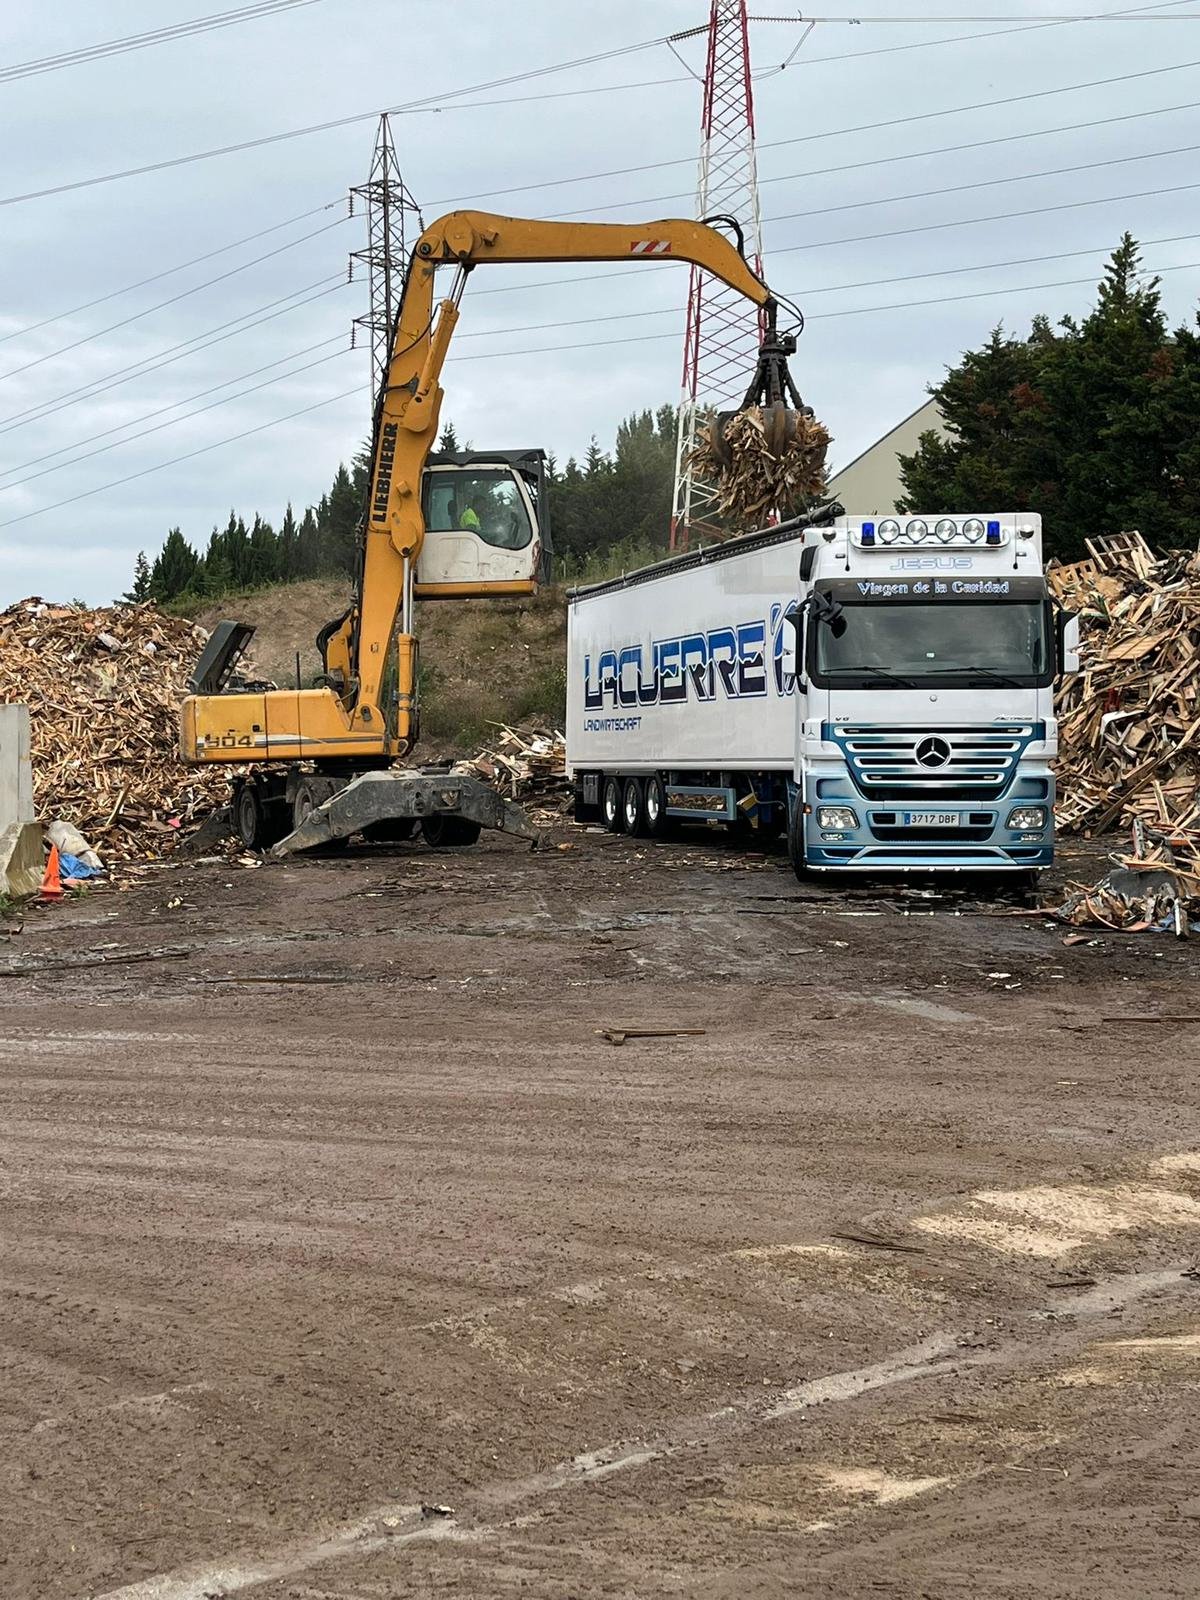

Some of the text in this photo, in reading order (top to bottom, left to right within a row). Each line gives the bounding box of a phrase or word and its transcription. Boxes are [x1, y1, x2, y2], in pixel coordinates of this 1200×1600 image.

[372, 422, 398, 522] LIEBHERR
[890, 557, 973, 570] JESUS
[856, 580, 1010, 597] Virgen de la Caridad
[584, 716, 642, 731] LANDWIRTSCHAFT
[911, 814, 936, 824] 3717
[938, 814, 957, 824] DBF
